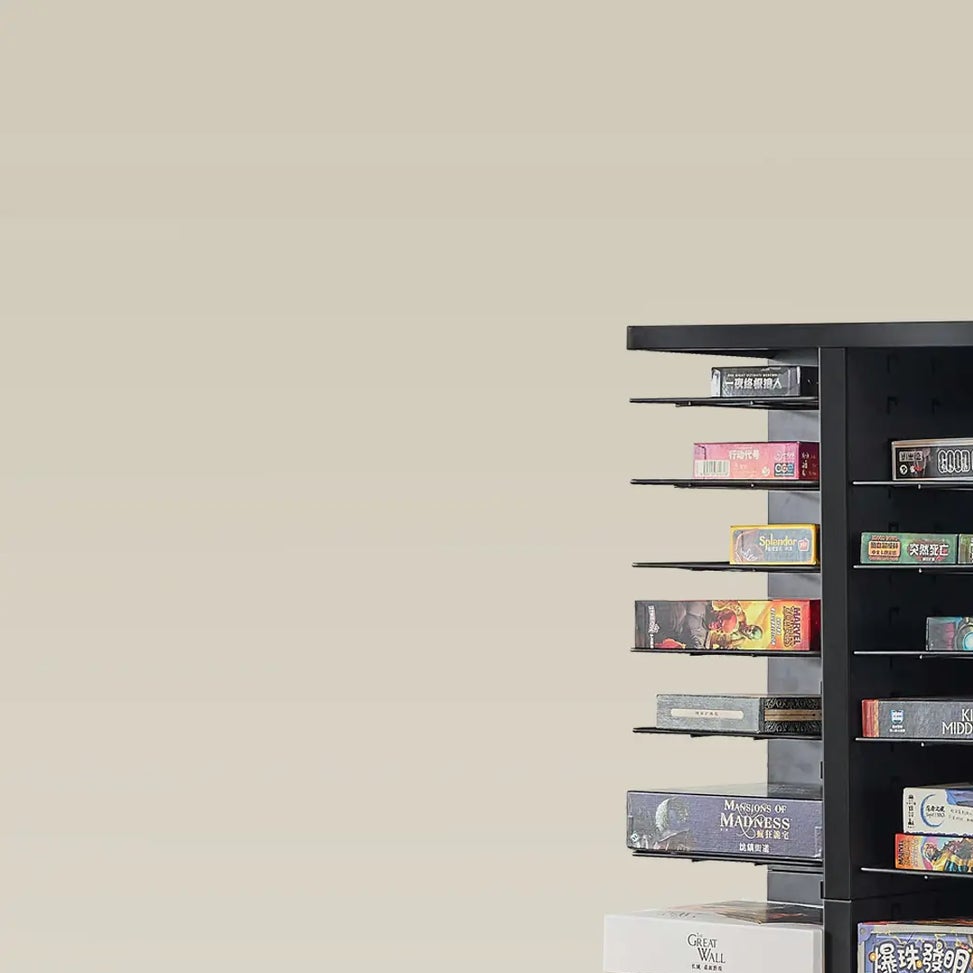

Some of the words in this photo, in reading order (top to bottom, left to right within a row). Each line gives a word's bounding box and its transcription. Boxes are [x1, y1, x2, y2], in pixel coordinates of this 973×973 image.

[938, 449, 970, 473] GOOD
[759, 533, 798, 551] Splendor
[909, 544, 949, 556] 突然死亡
[793, 607, 801, 645] MARVEL
[724, 799, 772, 813] MANSIONS
[774, 804, 787, 813] OF
[719, 812, 791, 830] MADNESS
[687, 933, 718, 948] GREAT
[697, 947, 726, 963] WALL
